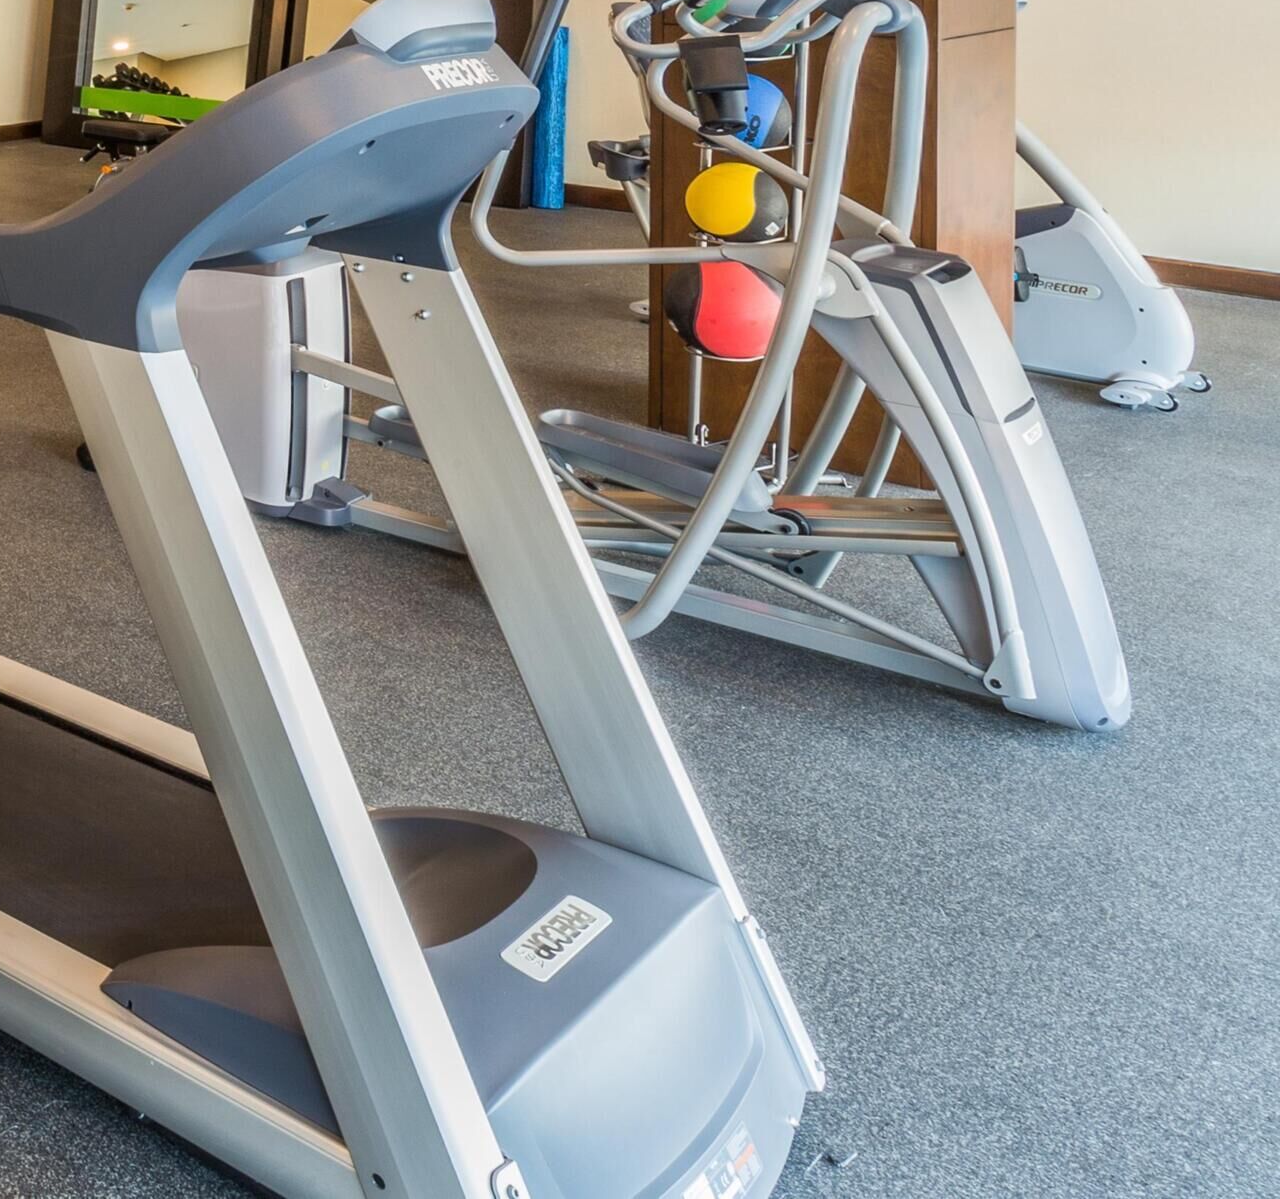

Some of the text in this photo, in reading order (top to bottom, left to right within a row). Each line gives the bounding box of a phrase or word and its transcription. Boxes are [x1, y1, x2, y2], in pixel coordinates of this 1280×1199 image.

[421, 58, 493, 90] PRECOR
[1038, 280, 1089, 296] PRECOR
[521, 903, 597, 960] PRECOR
